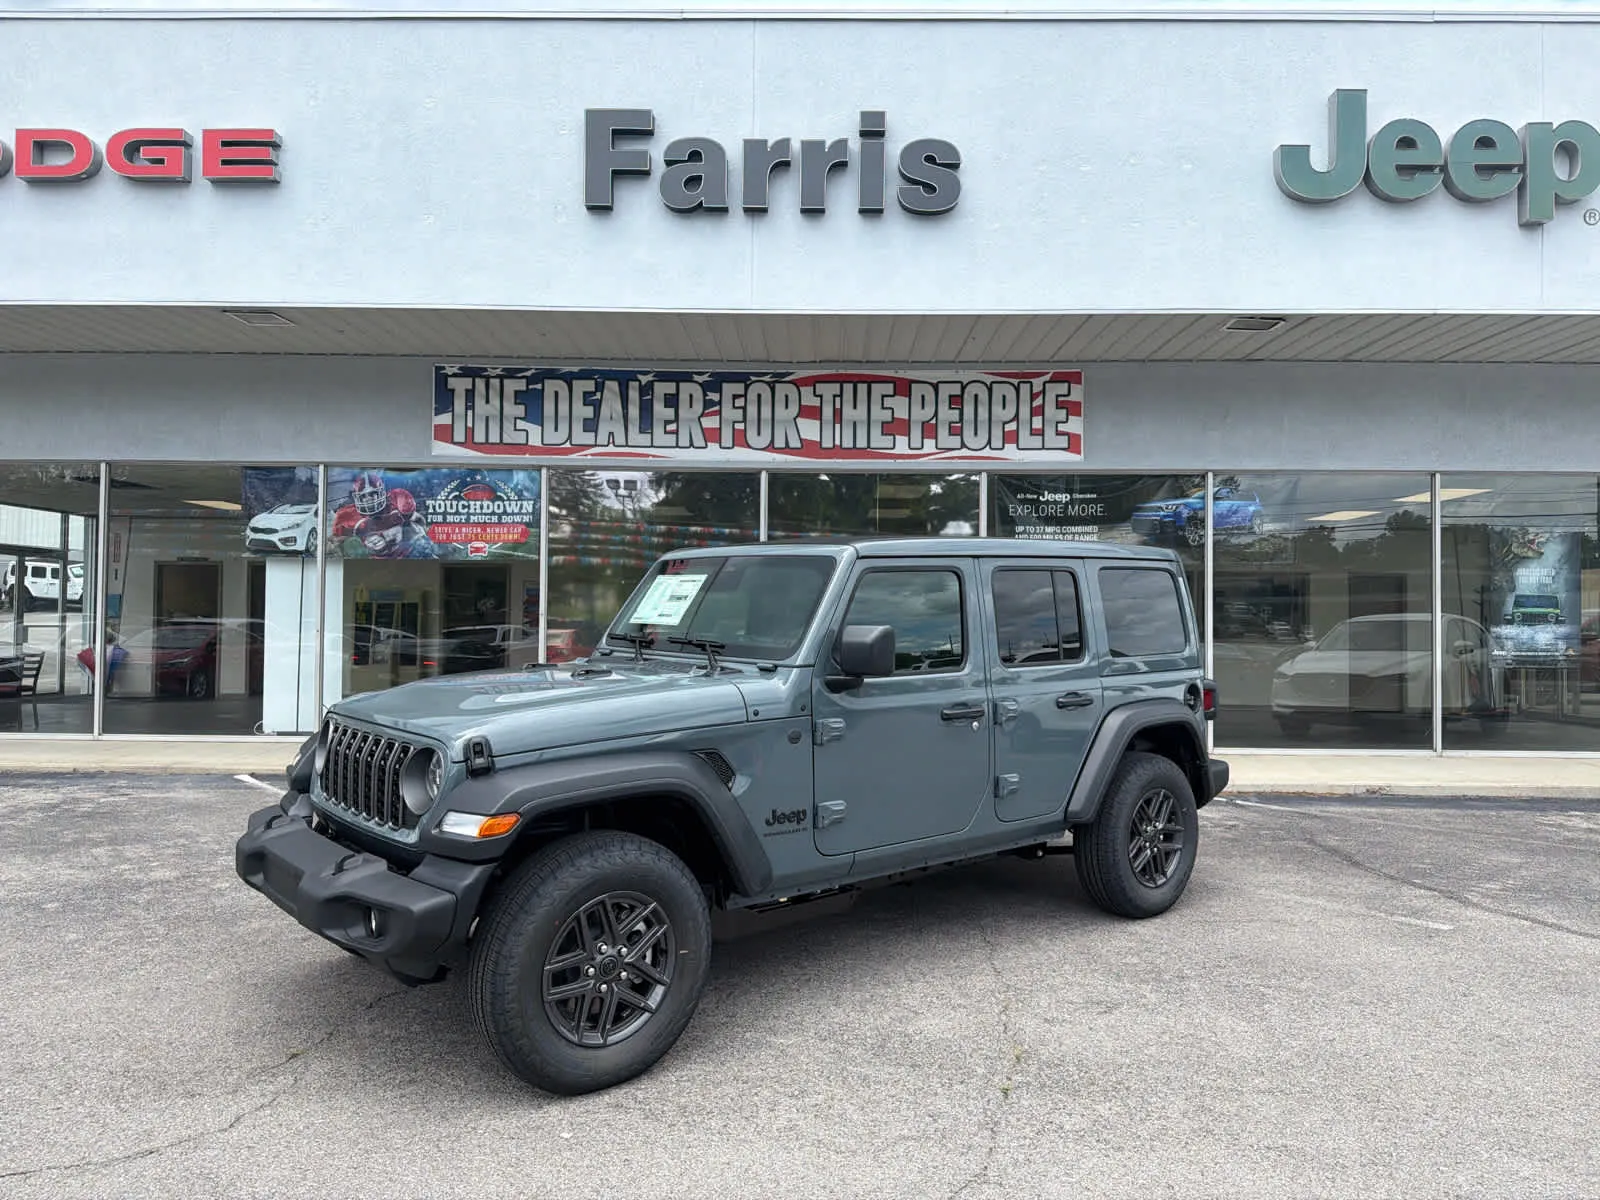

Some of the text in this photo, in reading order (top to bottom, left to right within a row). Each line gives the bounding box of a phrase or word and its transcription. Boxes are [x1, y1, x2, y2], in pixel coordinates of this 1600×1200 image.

[0, 128, 282, 184] DGE
[584, 108, 962, 215] Farris
[1273, 88, 1600, 227] Jeep
[447, 376, 1071, 451] THE DEALER FOR THE PEOPLE
[1039, 490, 1071, 503] Jeep
[425, 500, 534, 514] TOUCHDOWN
[1008, 504, 1108, 517] EXPLORE MORE.
[427, 514, 443, 522] FOR
[470, 515, 498, 523] MUCH
[502, 515, 533, 523] DOWN!
[765, 808, 808, 827] Jeep
